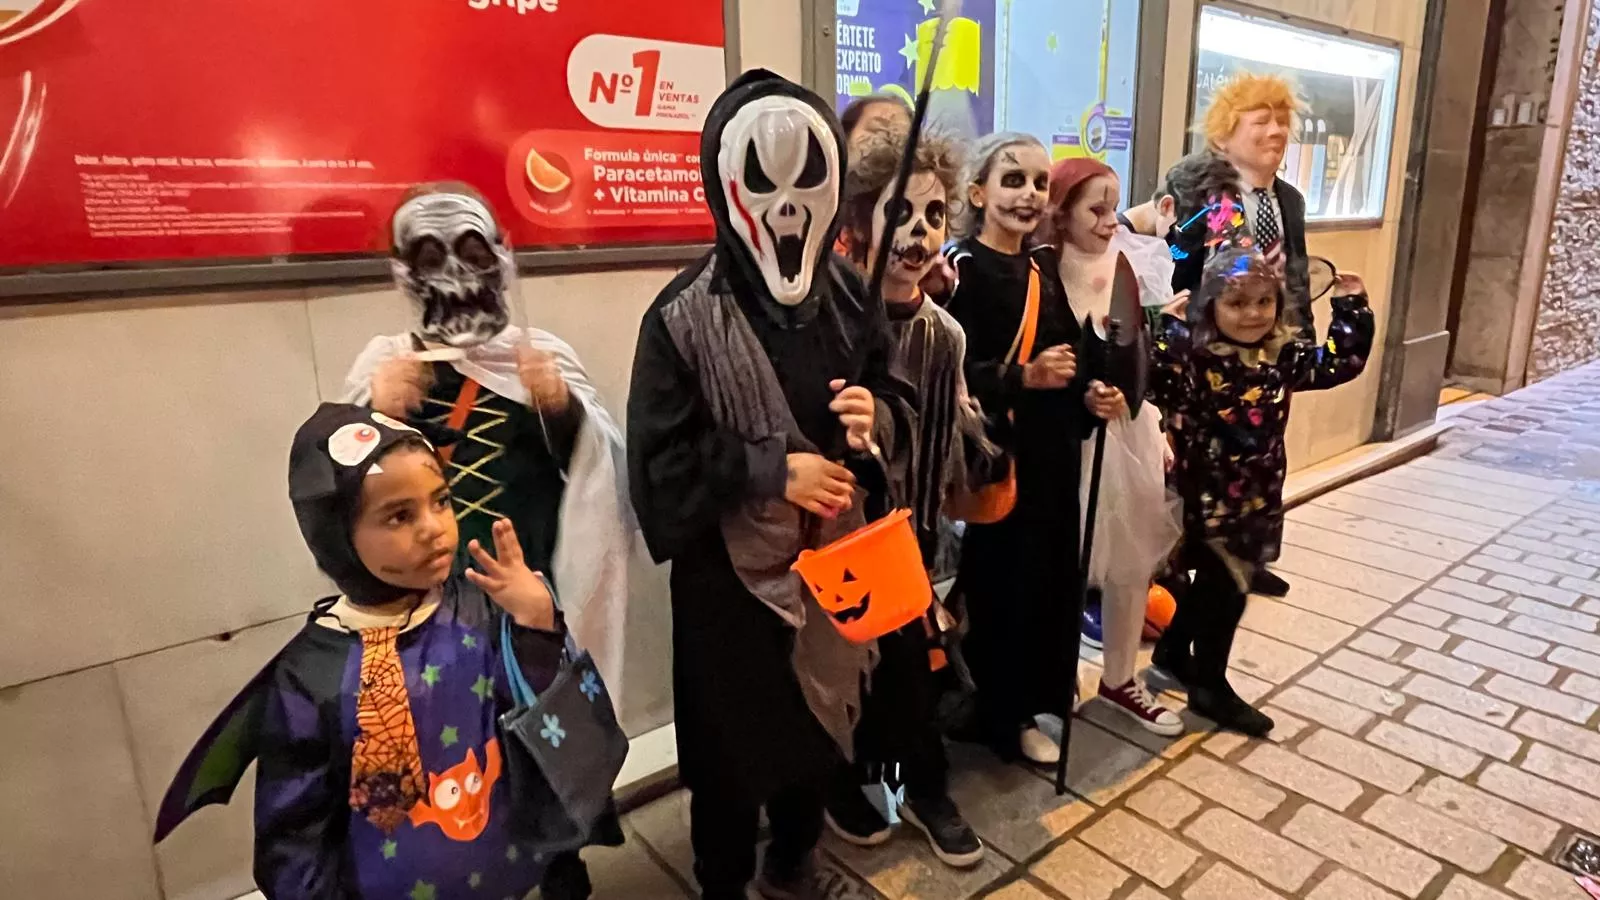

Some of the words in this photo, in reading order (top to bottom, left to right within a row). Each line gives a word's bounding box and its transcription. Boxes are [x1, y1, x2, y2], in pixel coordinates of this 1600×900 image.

[837, 49, 881, 73] EXPERTO
[659, 81, 674, 90] EN
[659, 92, 700, 104] VENTAS
[609, 186, 689, 203] Vitamina
[693, 186, 704, 202] C
